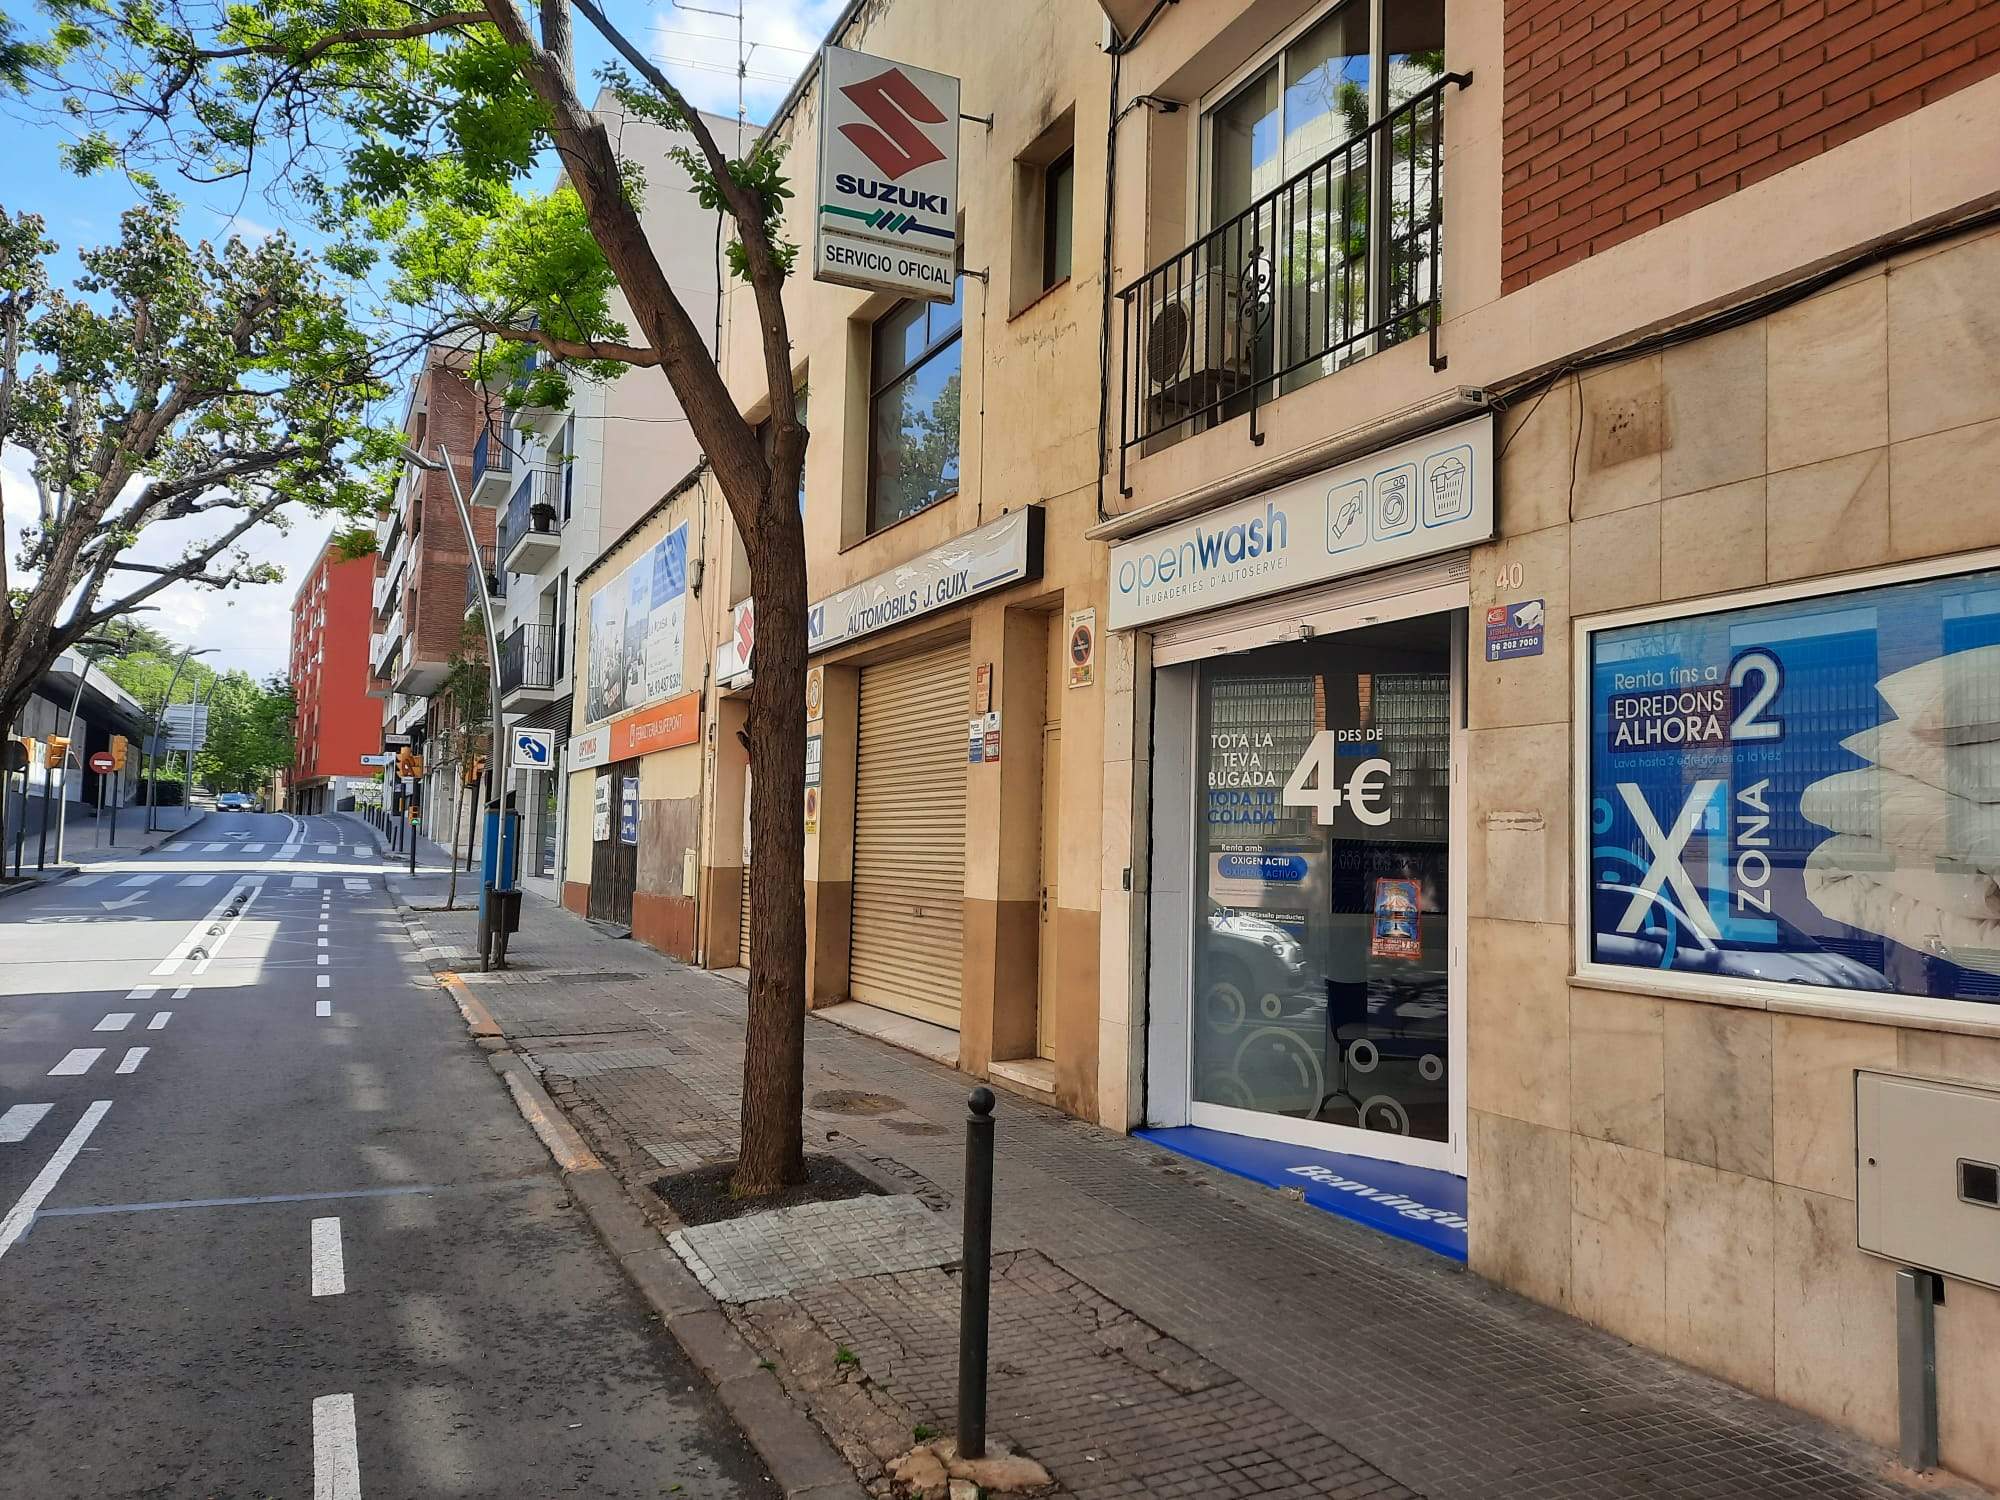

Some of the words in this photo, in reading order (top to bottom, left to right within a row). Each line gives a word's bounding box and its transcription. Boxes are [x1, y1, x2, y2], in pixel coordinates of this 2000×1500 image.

[835, 174, 948, 215] SUZUKI
[826, 245, 892, 273] SERVICIO
[898, 259, 951, 285] OFICIAL
[923, 584, 933, 609] J.
[936, 570, 969, 601] GUIX
[1145, 580, 1203, 604] BUGADERIES
[1211, 557, 1288, 587] D'AUTOSERVEI
[1496, 562, 1525, 591] 40
[1519, 637, 1538, 647] 7000
[1614, 669, 1664, 690] Renta
[1670, 664, 1698, 685] fins
[1704, 665, 1718, 681] a
[1729, 653, 1781, 741] 2
[1614, 689, 1724, 720] EDREDONS
[1211, 734, 1249, 748] TOTA
[1255, 733, 1273, 747] LA
[1338, 729, 1361, 742] DES
[1366, 728, 1383, 741] DE
[1614, 714, 1724, 747] ALHORA
[1222, 752, 1260, 767] TEVA
[1614, 758, 1635, 768] Lava
[1639, 756, 1666, 767] hasta
[1208, 771, 1276, 786] BUGADA
[1209, 790, 1251, 805] TODA
[1257, 789, 1275, 806] TU
[1208, 809, 1276, 824] COLADA
[1221, 843, 1243, 852] Renta
[1244, 844, 1263, 852] amb
[1736, 778, 1771, 913] ZONA
[1230, 856, 1263, 865] OXIGEN
[1265, 858, 1290, 866] ACTIU
[1616, 778, 1778, 944] XL
[1286, 1165, 1468, 1232] Benvingu
